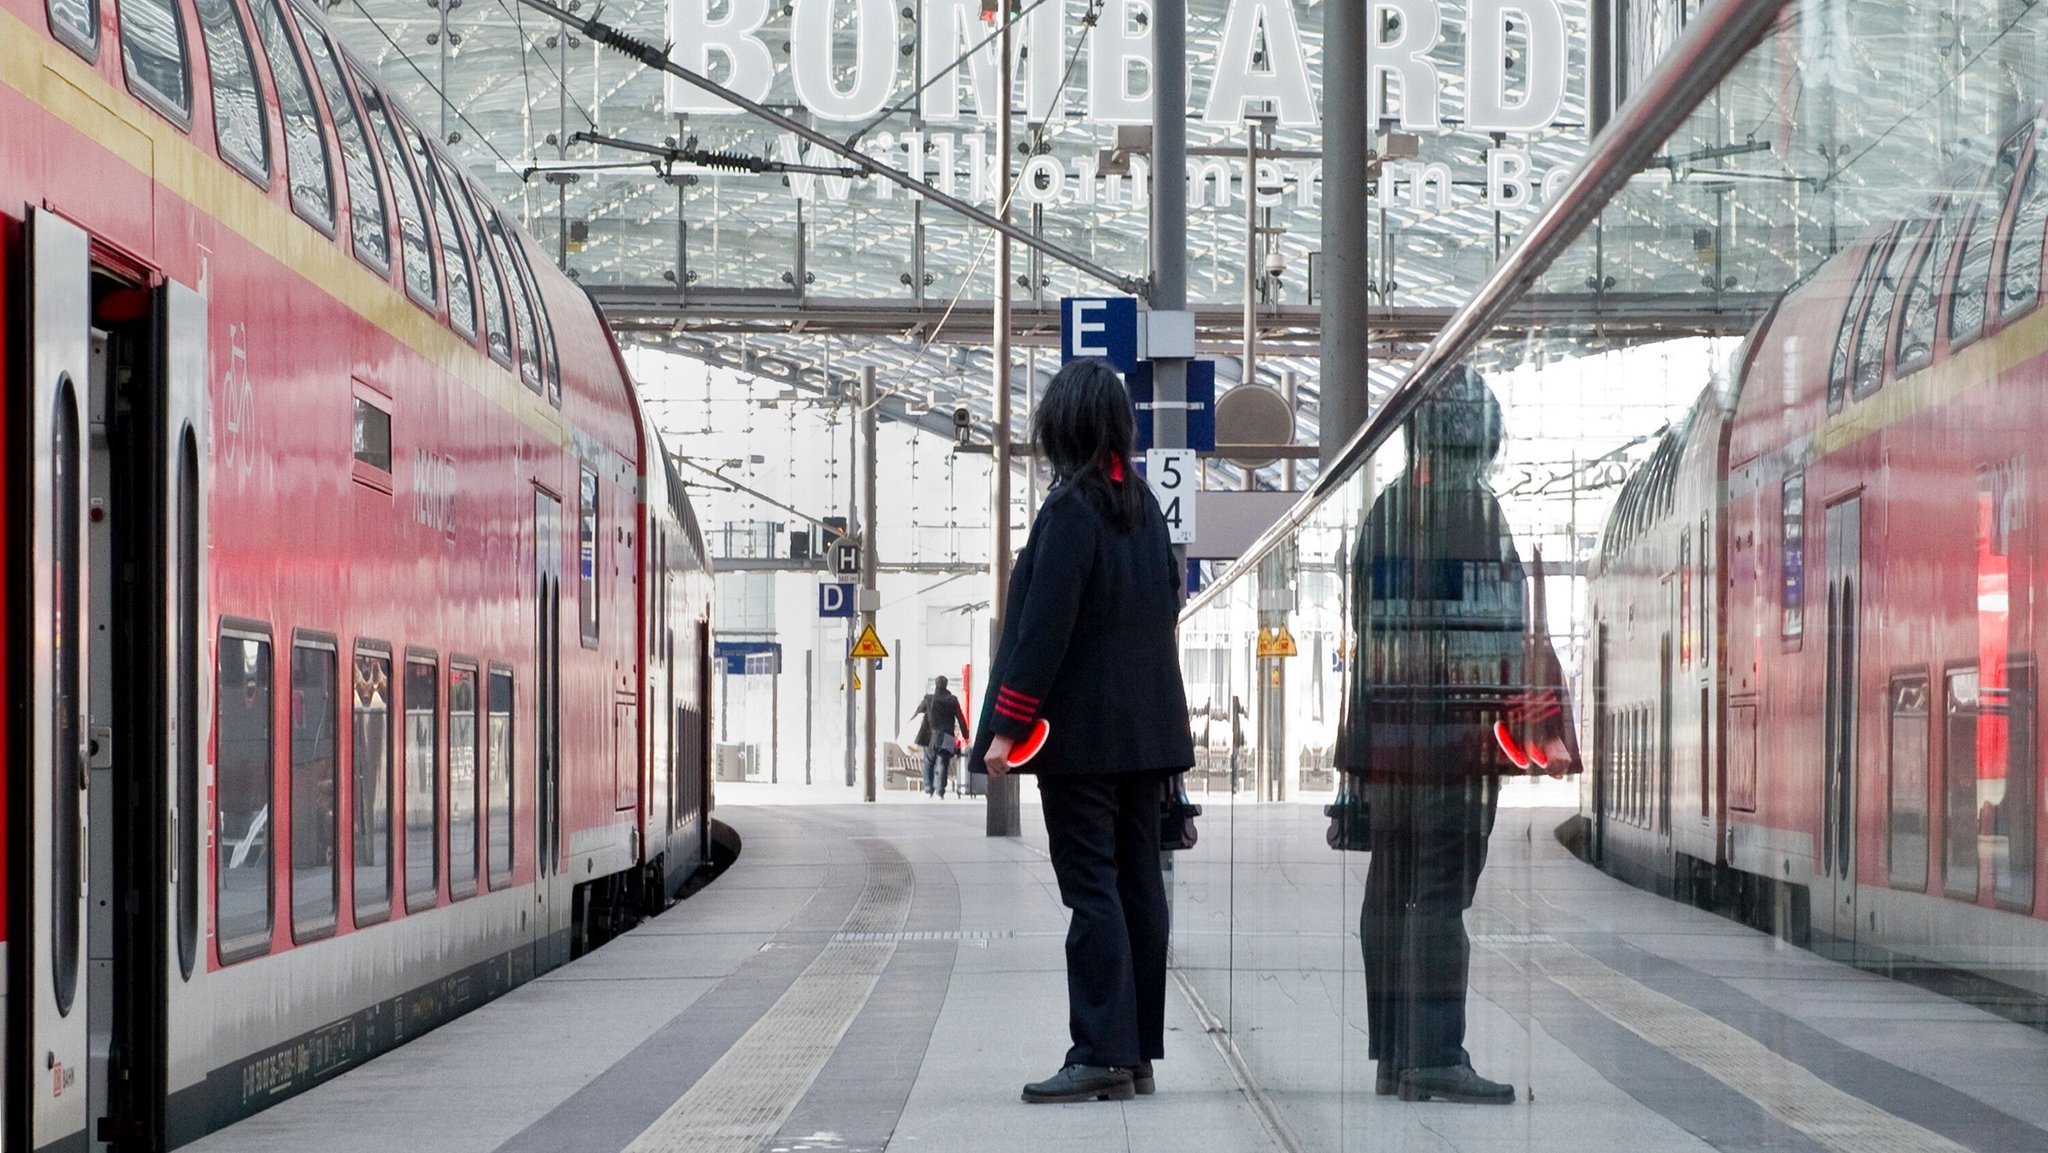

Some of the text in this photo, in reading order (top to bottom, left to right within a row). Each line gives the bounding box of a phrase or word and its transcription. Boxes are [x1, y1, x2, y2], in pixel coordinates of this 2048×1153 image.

[1376, 160, 1453, 209] in
[1072, 300, 1107, 356] E
[1160, 456, 1182, 489] 5
[1163, 495, 1183, 529] 4
[840, 548, 855, 569] H
[823, 584, 843, 611] D
[886, 755, 894, 784] Aball
